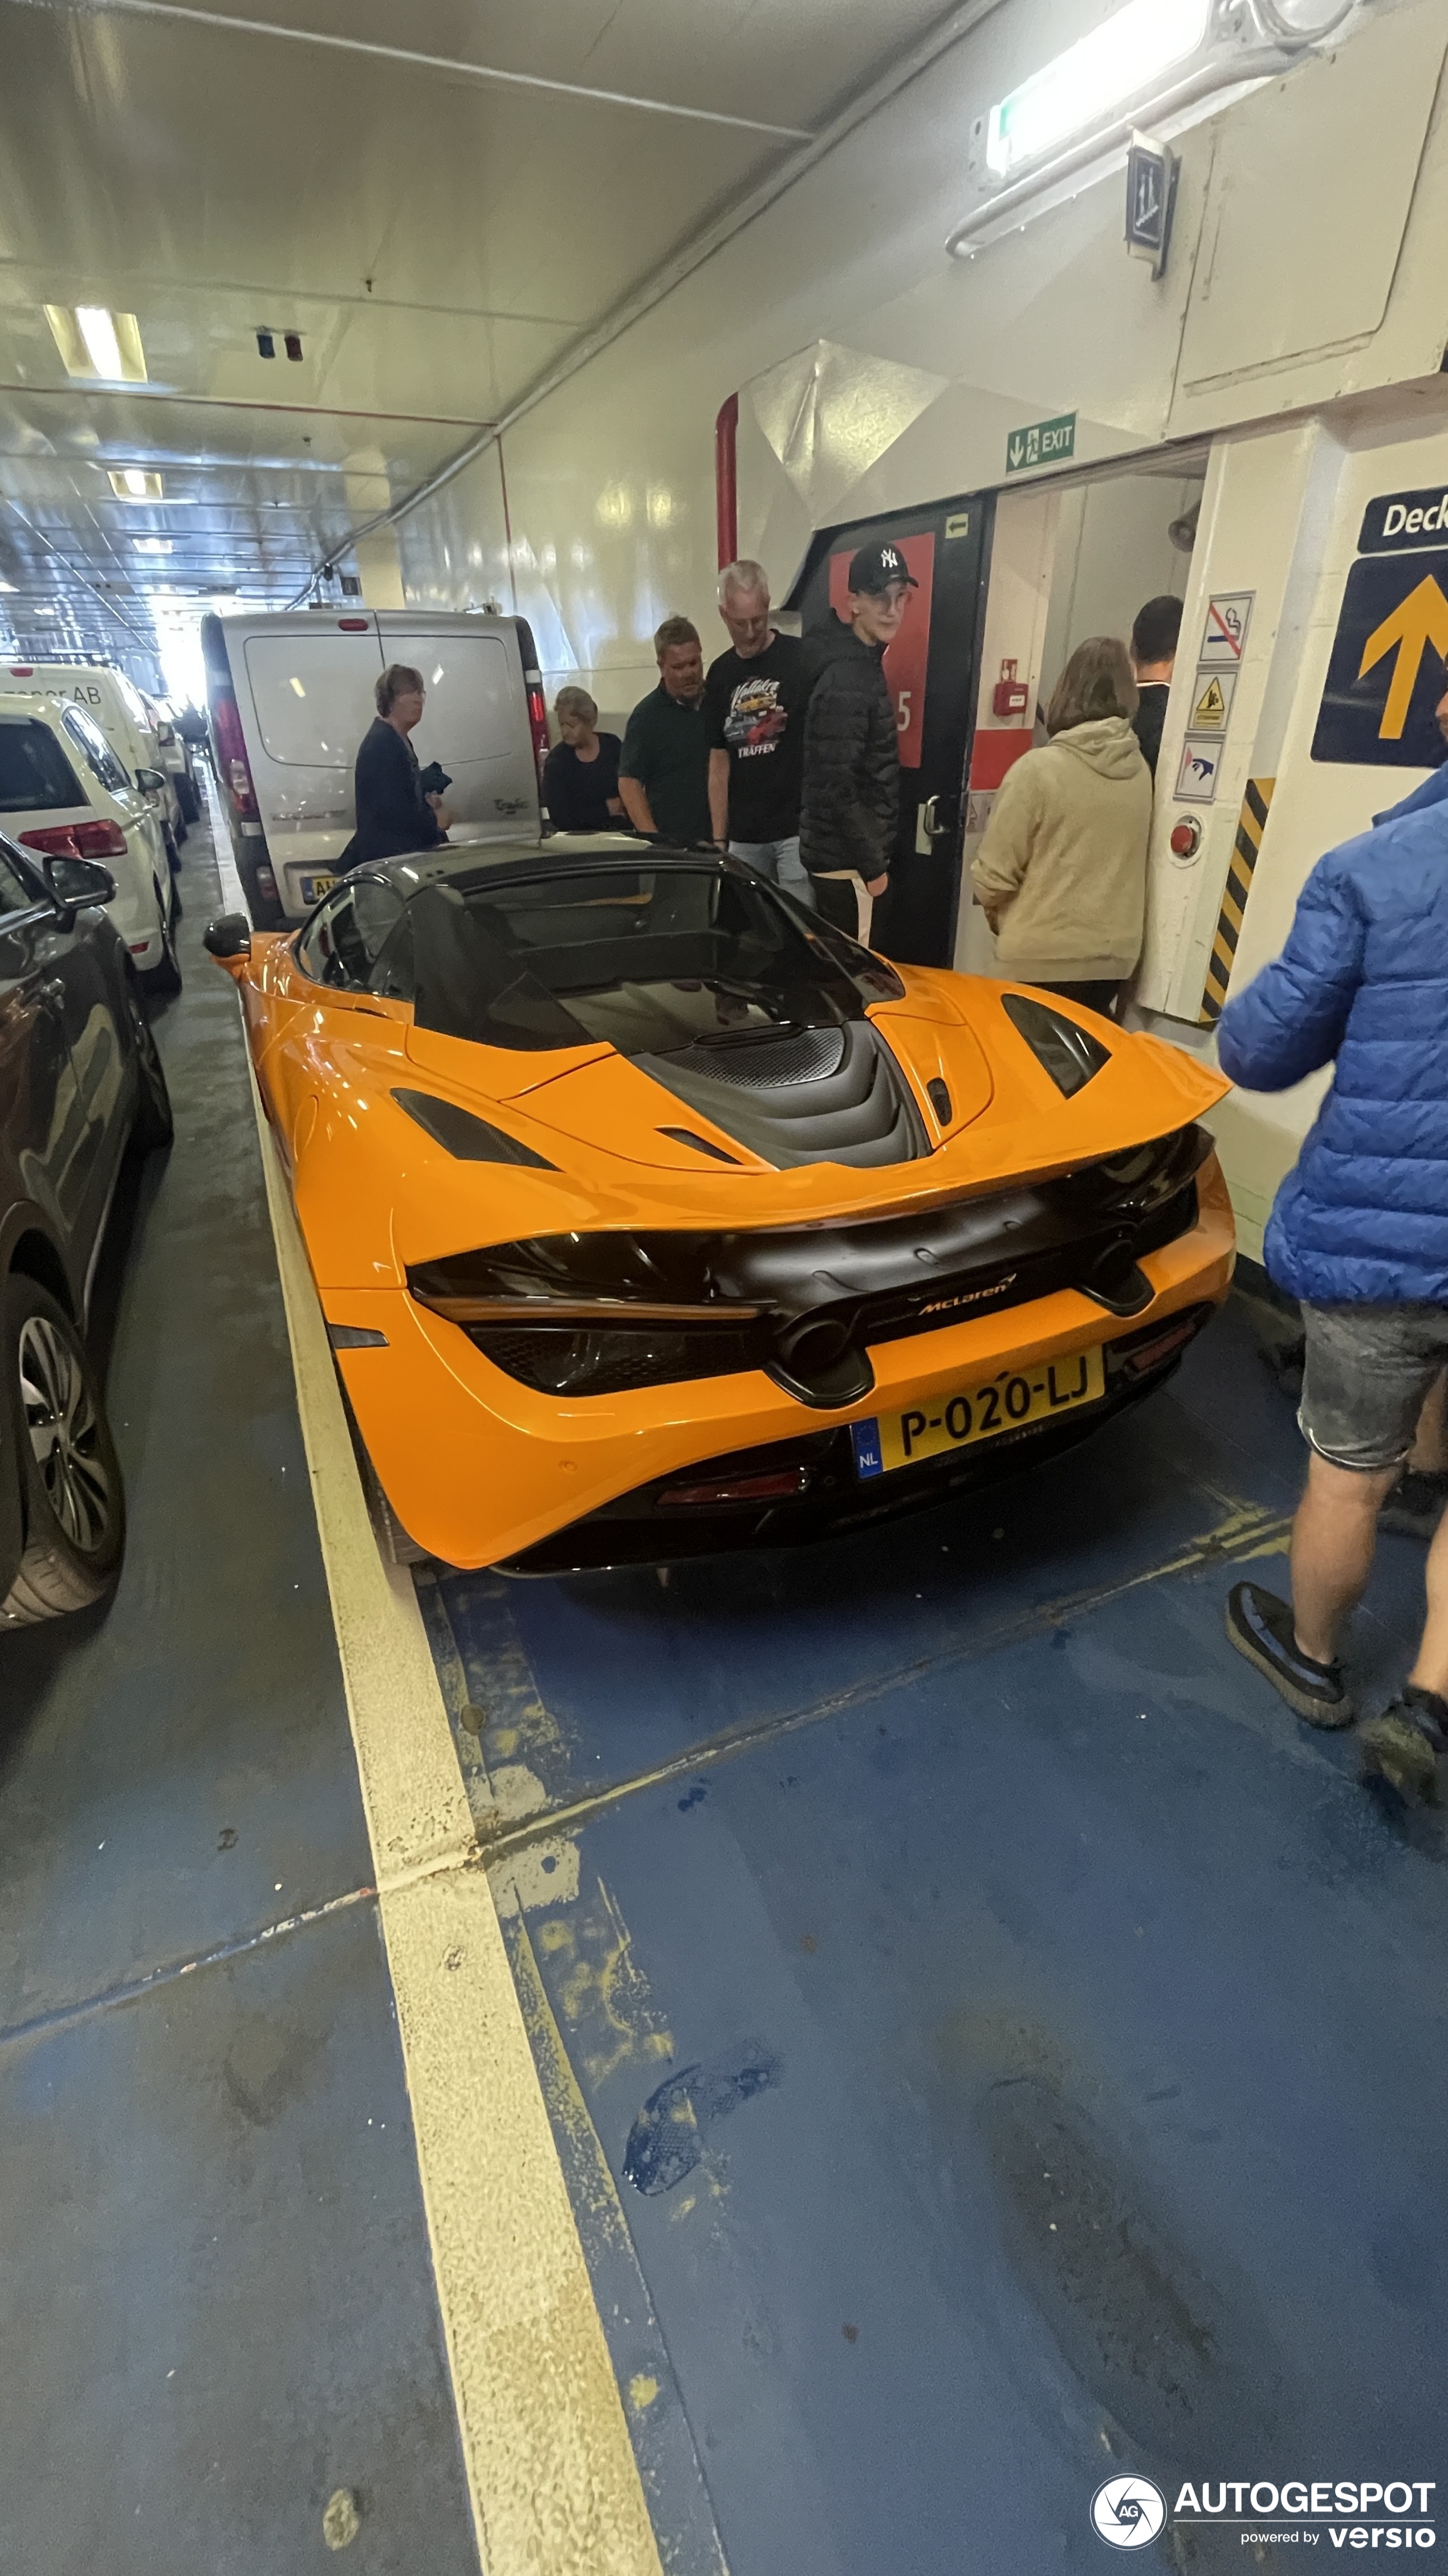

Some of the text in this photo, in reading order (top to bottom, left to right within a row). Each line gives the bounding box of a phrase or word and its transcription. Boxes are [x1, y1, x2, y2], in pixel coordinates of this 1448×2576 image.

[1042, 426, 1073, 453] EXIT
[881, 548, 898, 568] NY
[74, 686, 101, 705] AB
[897, 691, 912, 731] 5
[918, 1283, 1007, 1316] McLaren
[900, 1355, 1088, 1457] P-020-LJ
[860, 1454, 878, 1469] NL
